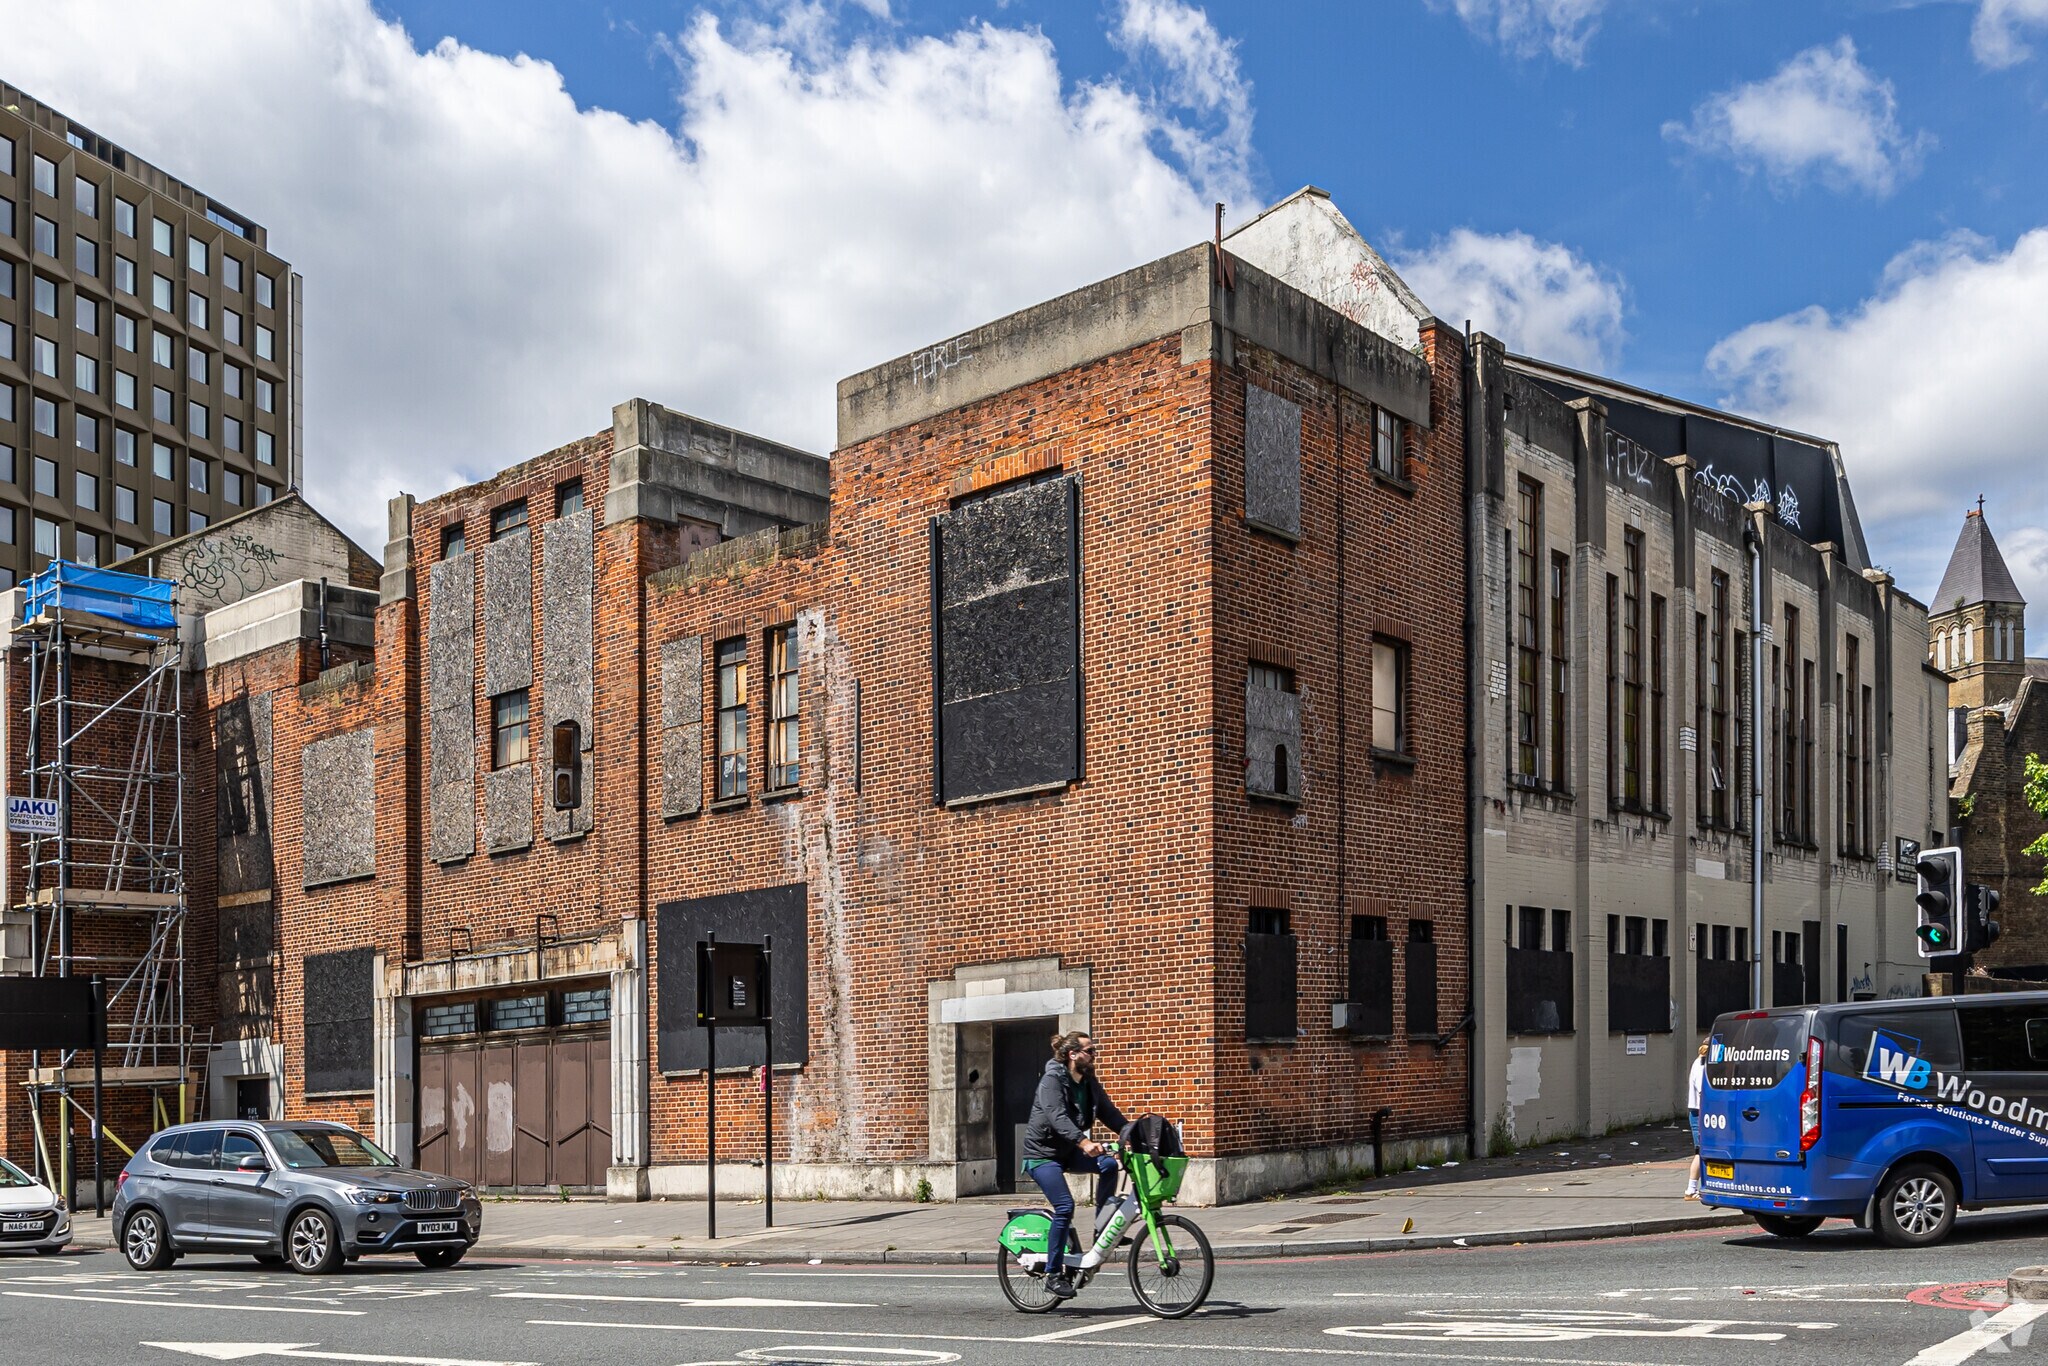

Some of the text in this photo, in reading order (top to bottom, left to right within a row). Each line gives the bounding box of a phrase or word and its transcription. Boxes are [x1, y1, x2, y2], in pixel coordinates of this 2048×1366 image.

[10, 800, 56, 815] JAKU
[1711, 1043, 1790, 1063] WB Woodmans
[1712, 1077, 1773, 1086] 0117 937 3910
[1879, 1047, 1932, 1090] WB
[1936, 1104, 1984, 1125] Solutions
[1991, 1120, 2026, 1138] Render
[1096, 1215, 1126, 1249] Lime
